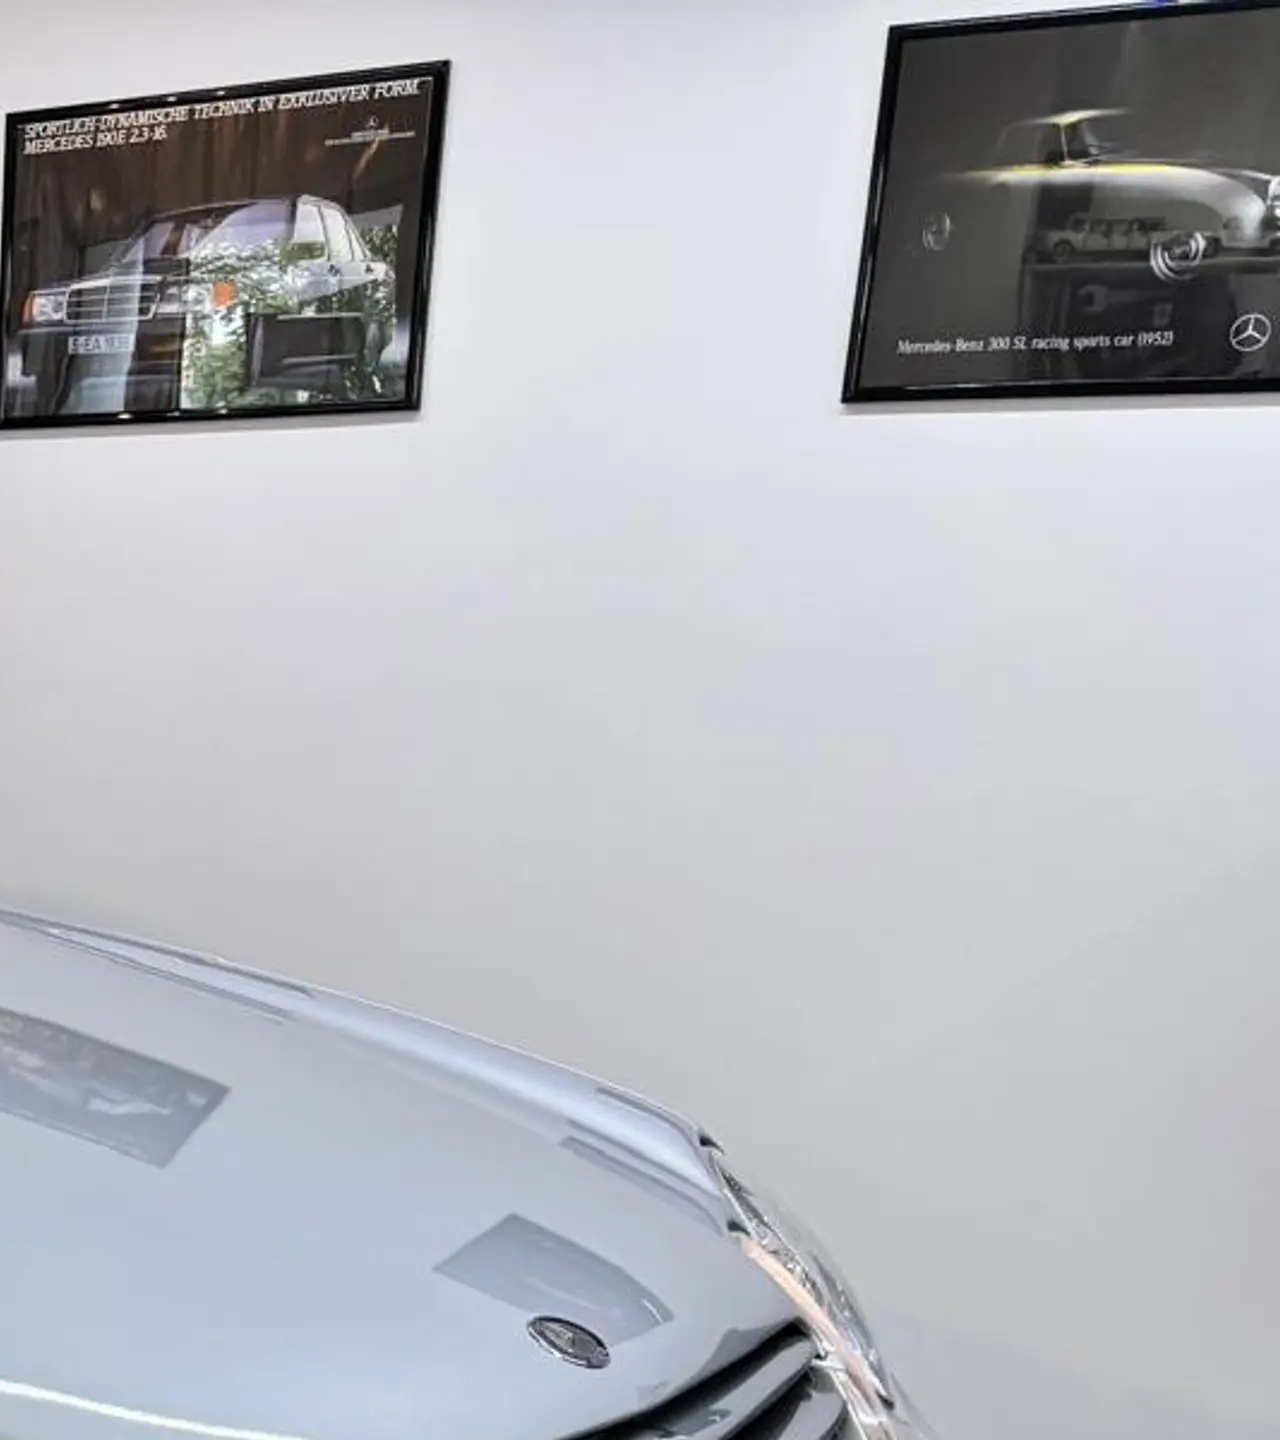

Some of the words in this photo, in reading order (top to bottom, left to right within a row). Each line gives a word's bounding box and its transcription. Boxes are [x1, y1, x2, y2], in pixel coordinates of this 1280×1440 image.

[257, 95, 277, 113] IN
[23, 134, 94, 155] MERCEDES
[1030, 336, 1070, 352] racing
[1072, 335, 1111, 352] sports
[1113, 334, 1135, 348] car
